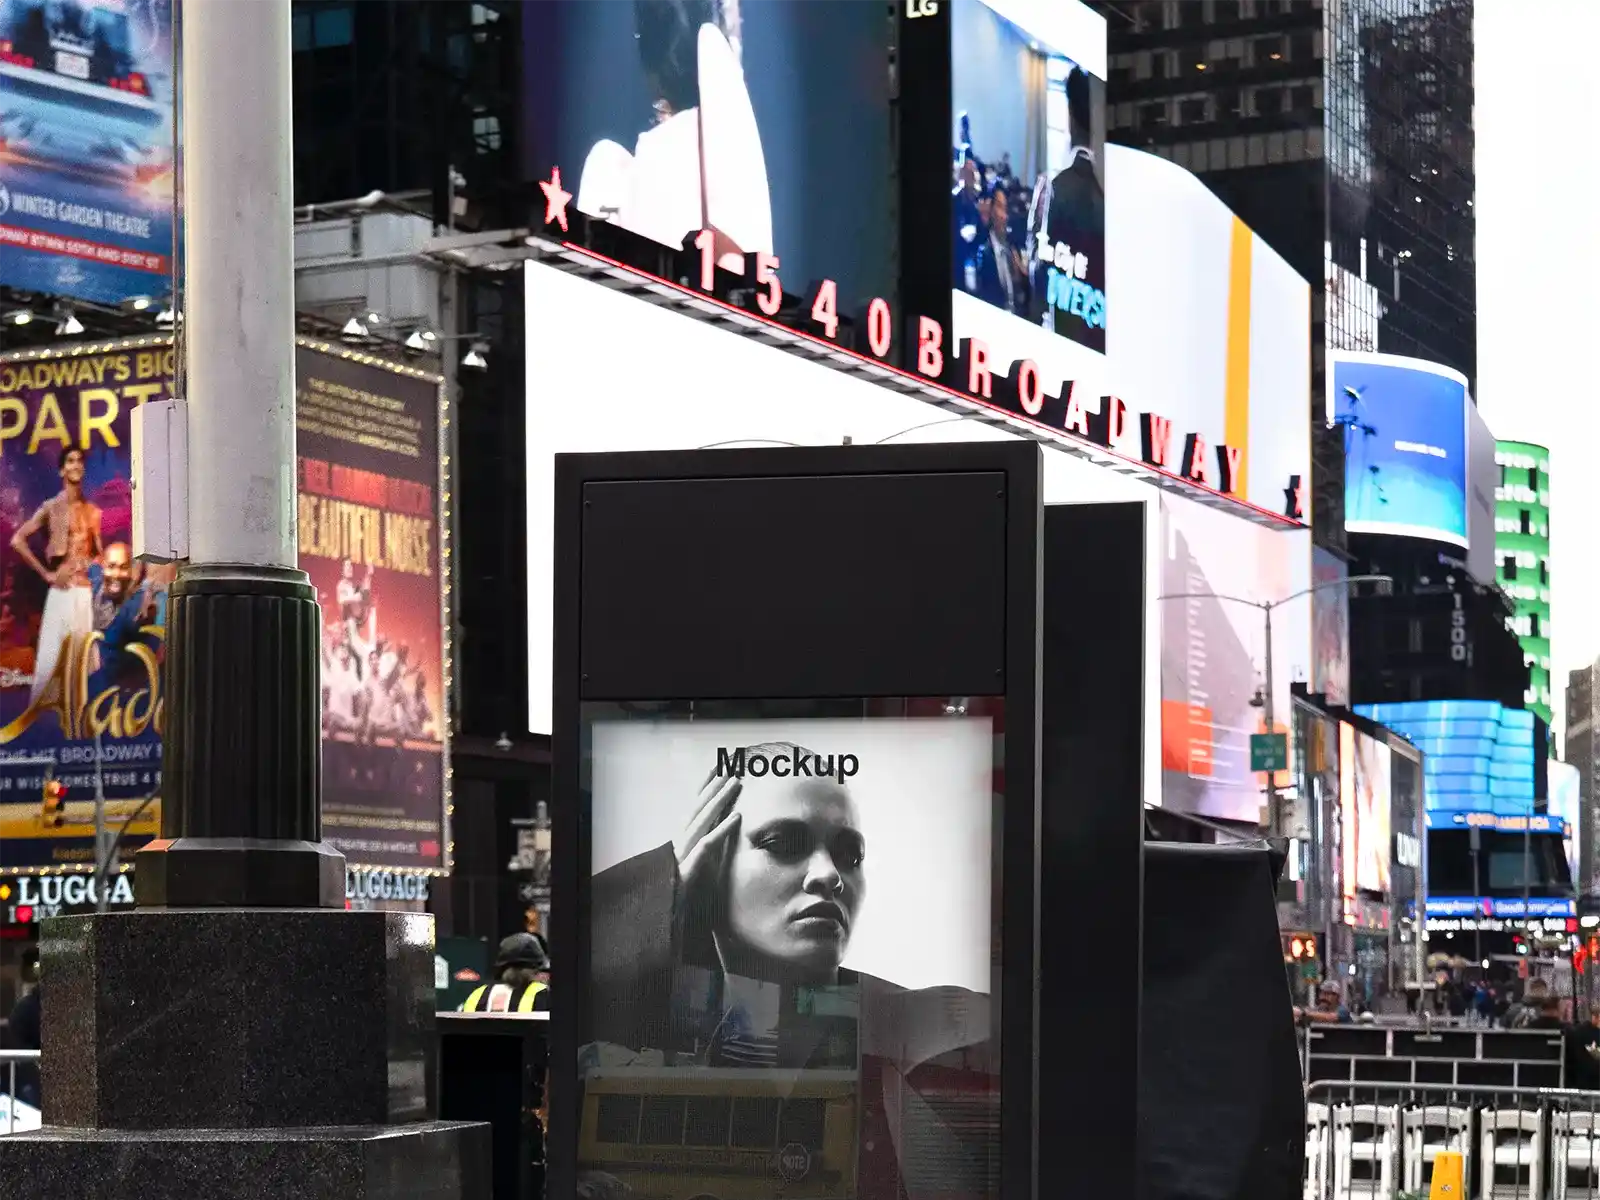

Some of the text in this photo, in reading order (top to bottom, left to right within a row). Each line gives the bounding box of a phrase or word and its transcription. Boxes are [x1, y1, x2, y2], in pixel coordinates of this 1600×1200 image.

[906, 0, 938, 18] LG
[57, 201, 104, 230] GARDEN
[0, 382, 175, 456] PART
[917, 315, 1242, 493] BROADWAY
[1451, 592, 1466, 661] 1500
[61, 743, 153, 763] BROADWAY
[716, 746, 859, 784] Mockup
[16, 874, 135, 905] LUGGA
[345, 870, 429, 900] LUGGAGE
